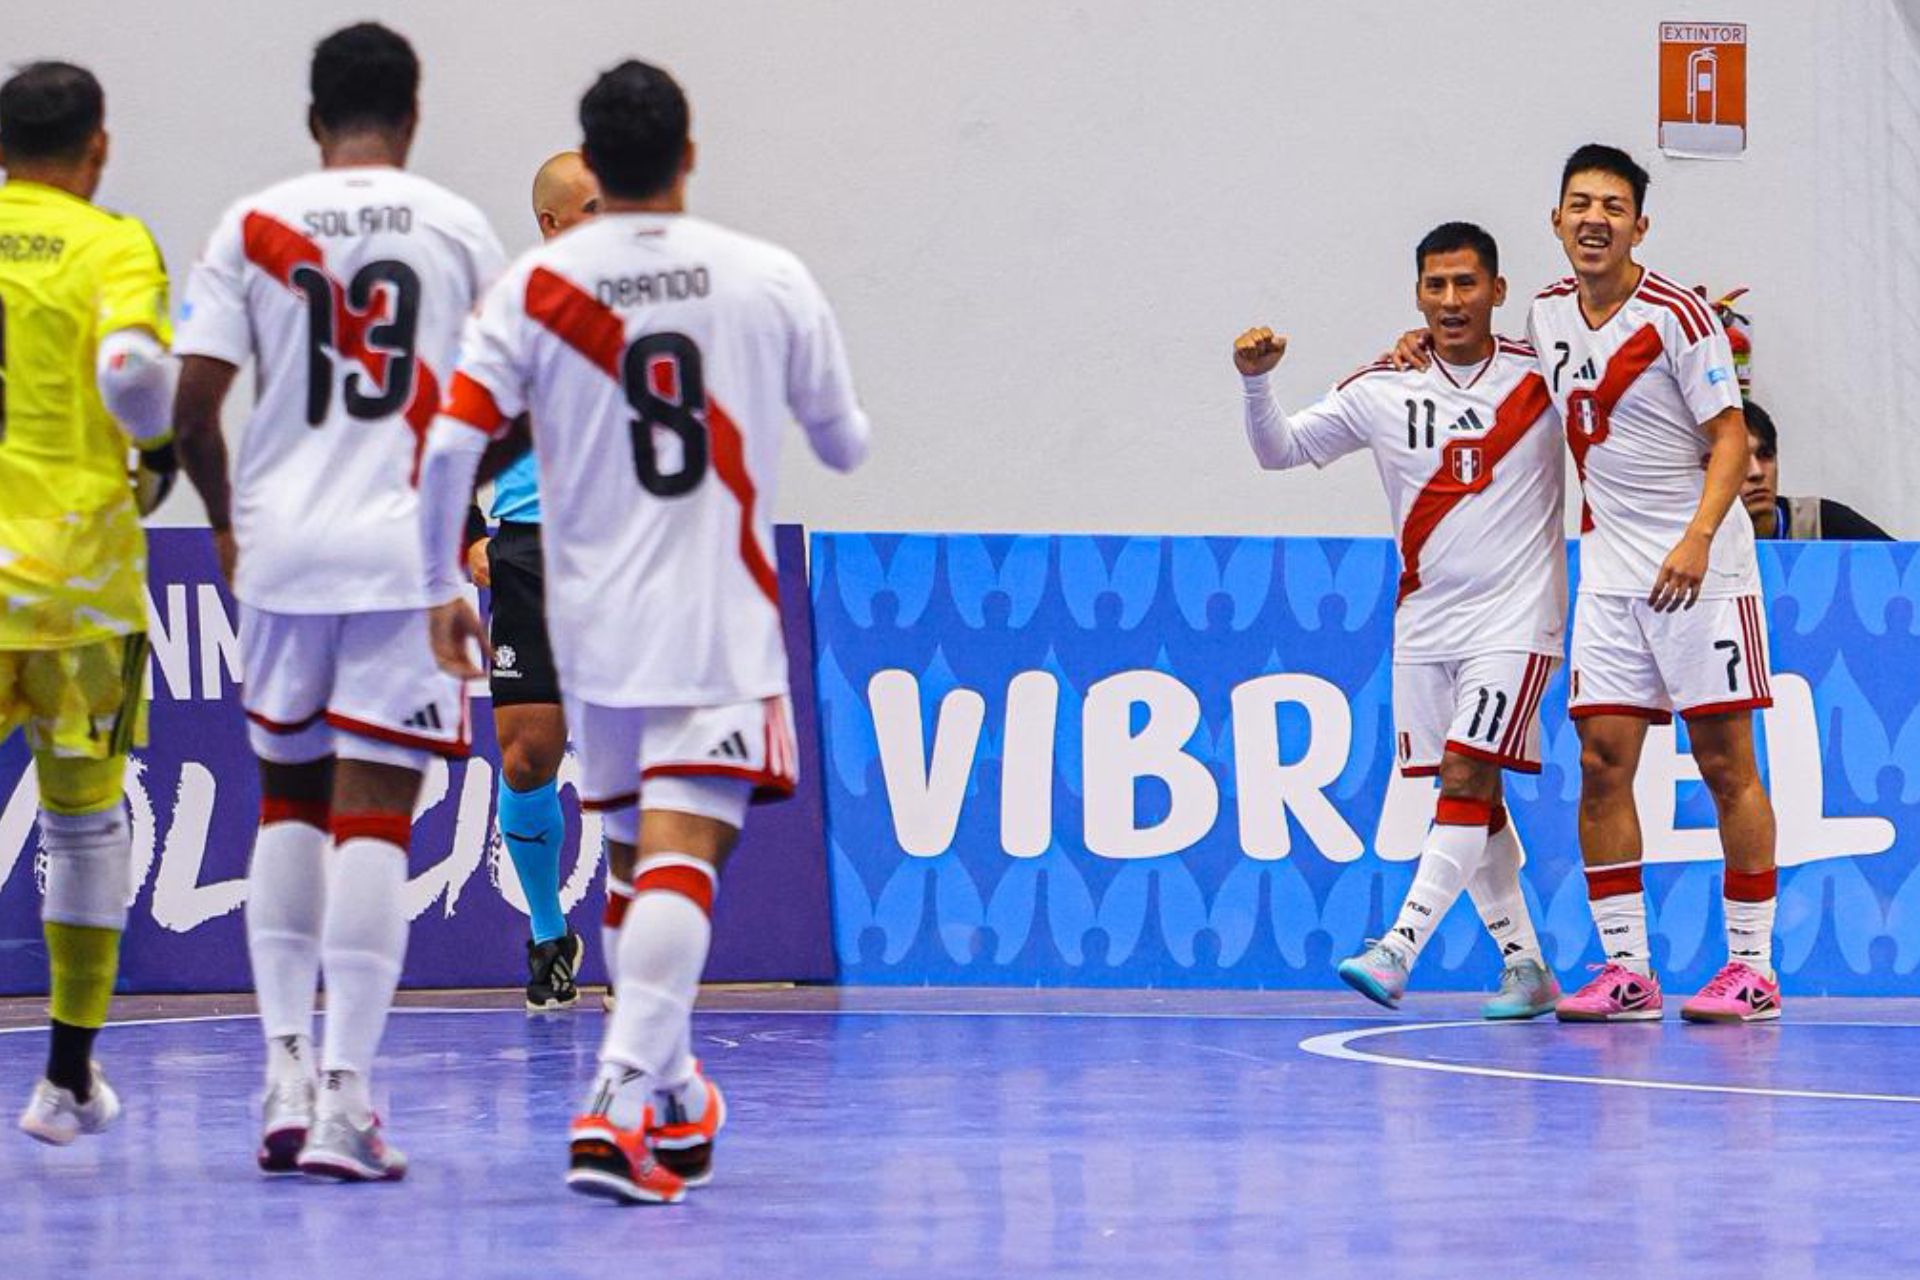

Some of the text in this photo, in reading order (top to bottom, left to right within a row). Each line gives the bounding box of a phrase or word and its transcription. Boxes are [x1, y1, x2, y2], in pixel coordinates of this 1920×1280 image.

[1664, 26, 1742, 42] EXTINTOR
[303, 206, 412, 238] SOLANO
[597, 267, 711, 309] OBANDO
[291, 259, 421, 427] 13
[1554, 341, 1570, 393] 7
[624, 332, 708, 496] 8
[1405, 399, 1437, 449] 11
[1714, 640, 1742, 692] 7
[1467, 687, 1508, 743] 11
